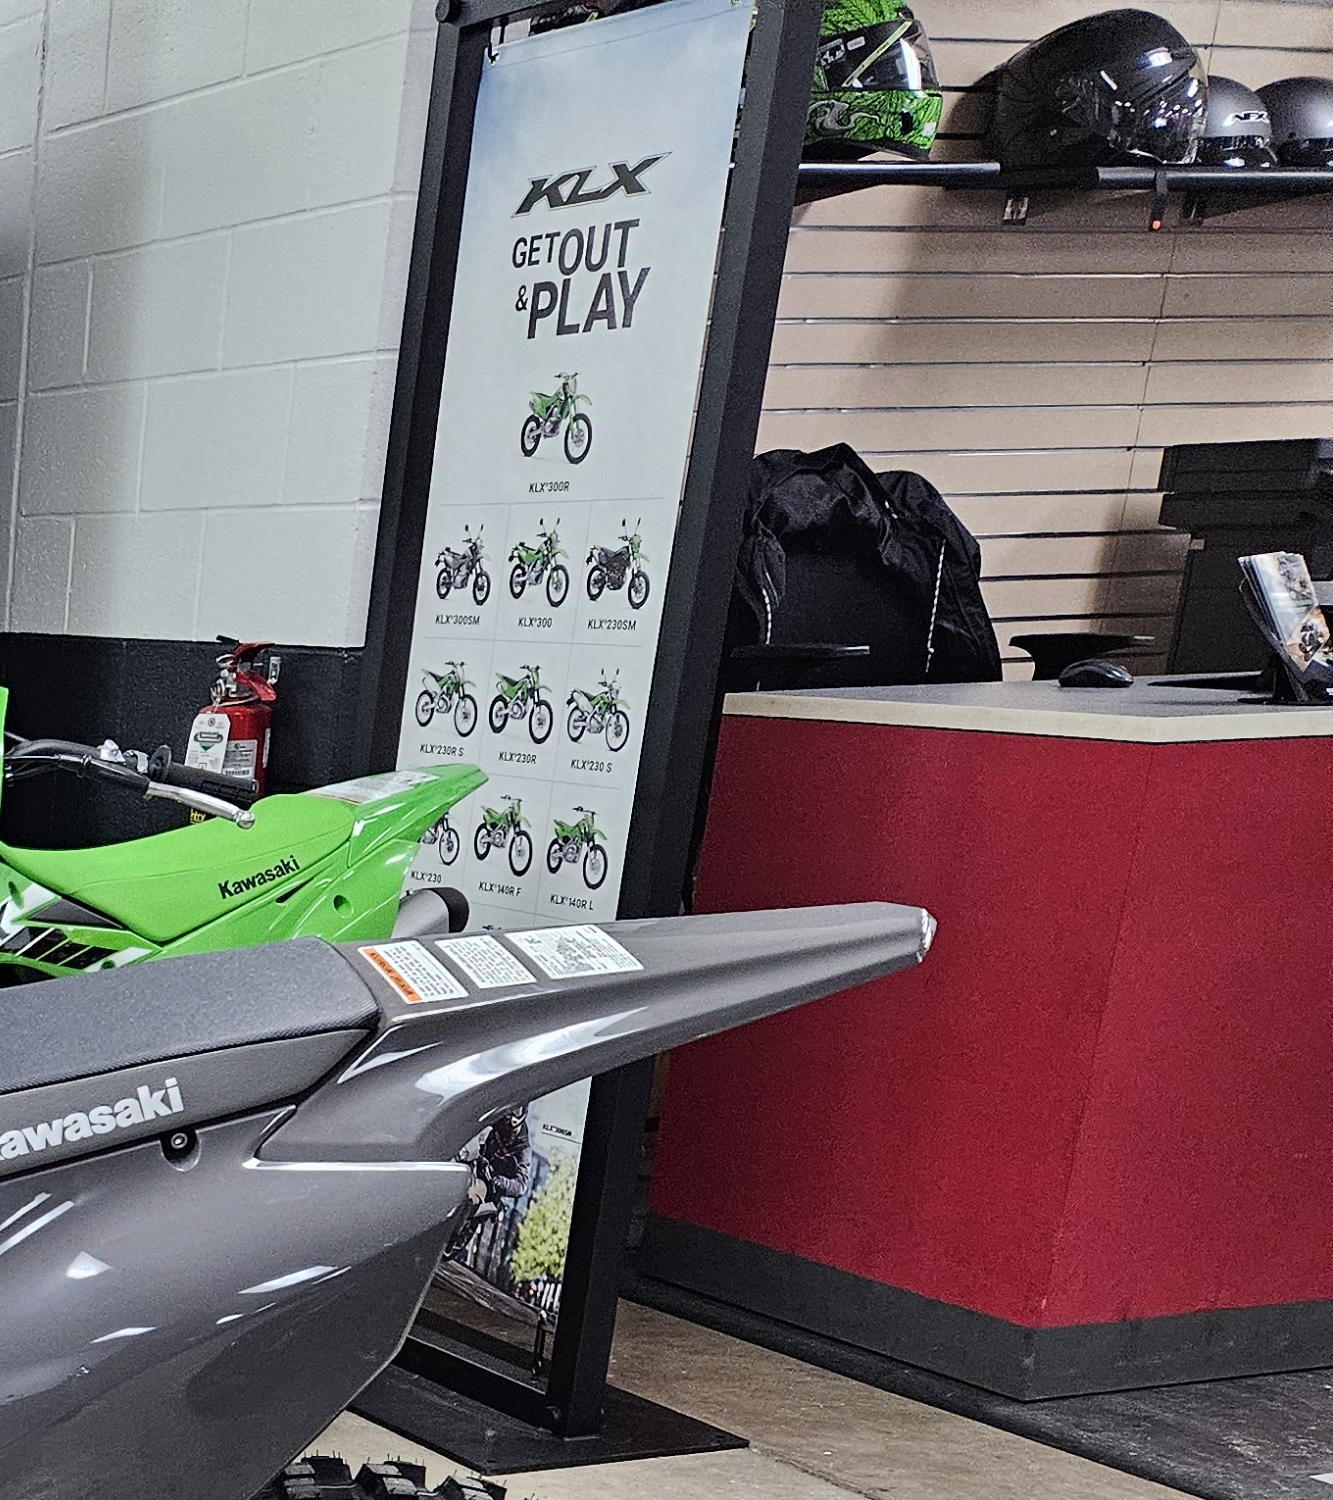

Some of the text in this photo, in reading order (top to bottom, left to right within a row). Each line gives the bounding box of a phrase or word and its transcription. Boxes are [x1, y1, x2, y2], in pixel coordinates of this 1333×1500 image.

[511, 151, 673, 218] KLX
[512, 218, 641, 276] GET OUT
[527, 266, 652, 340] PLAY
[217, 853, 302, 900] Kawasaki
